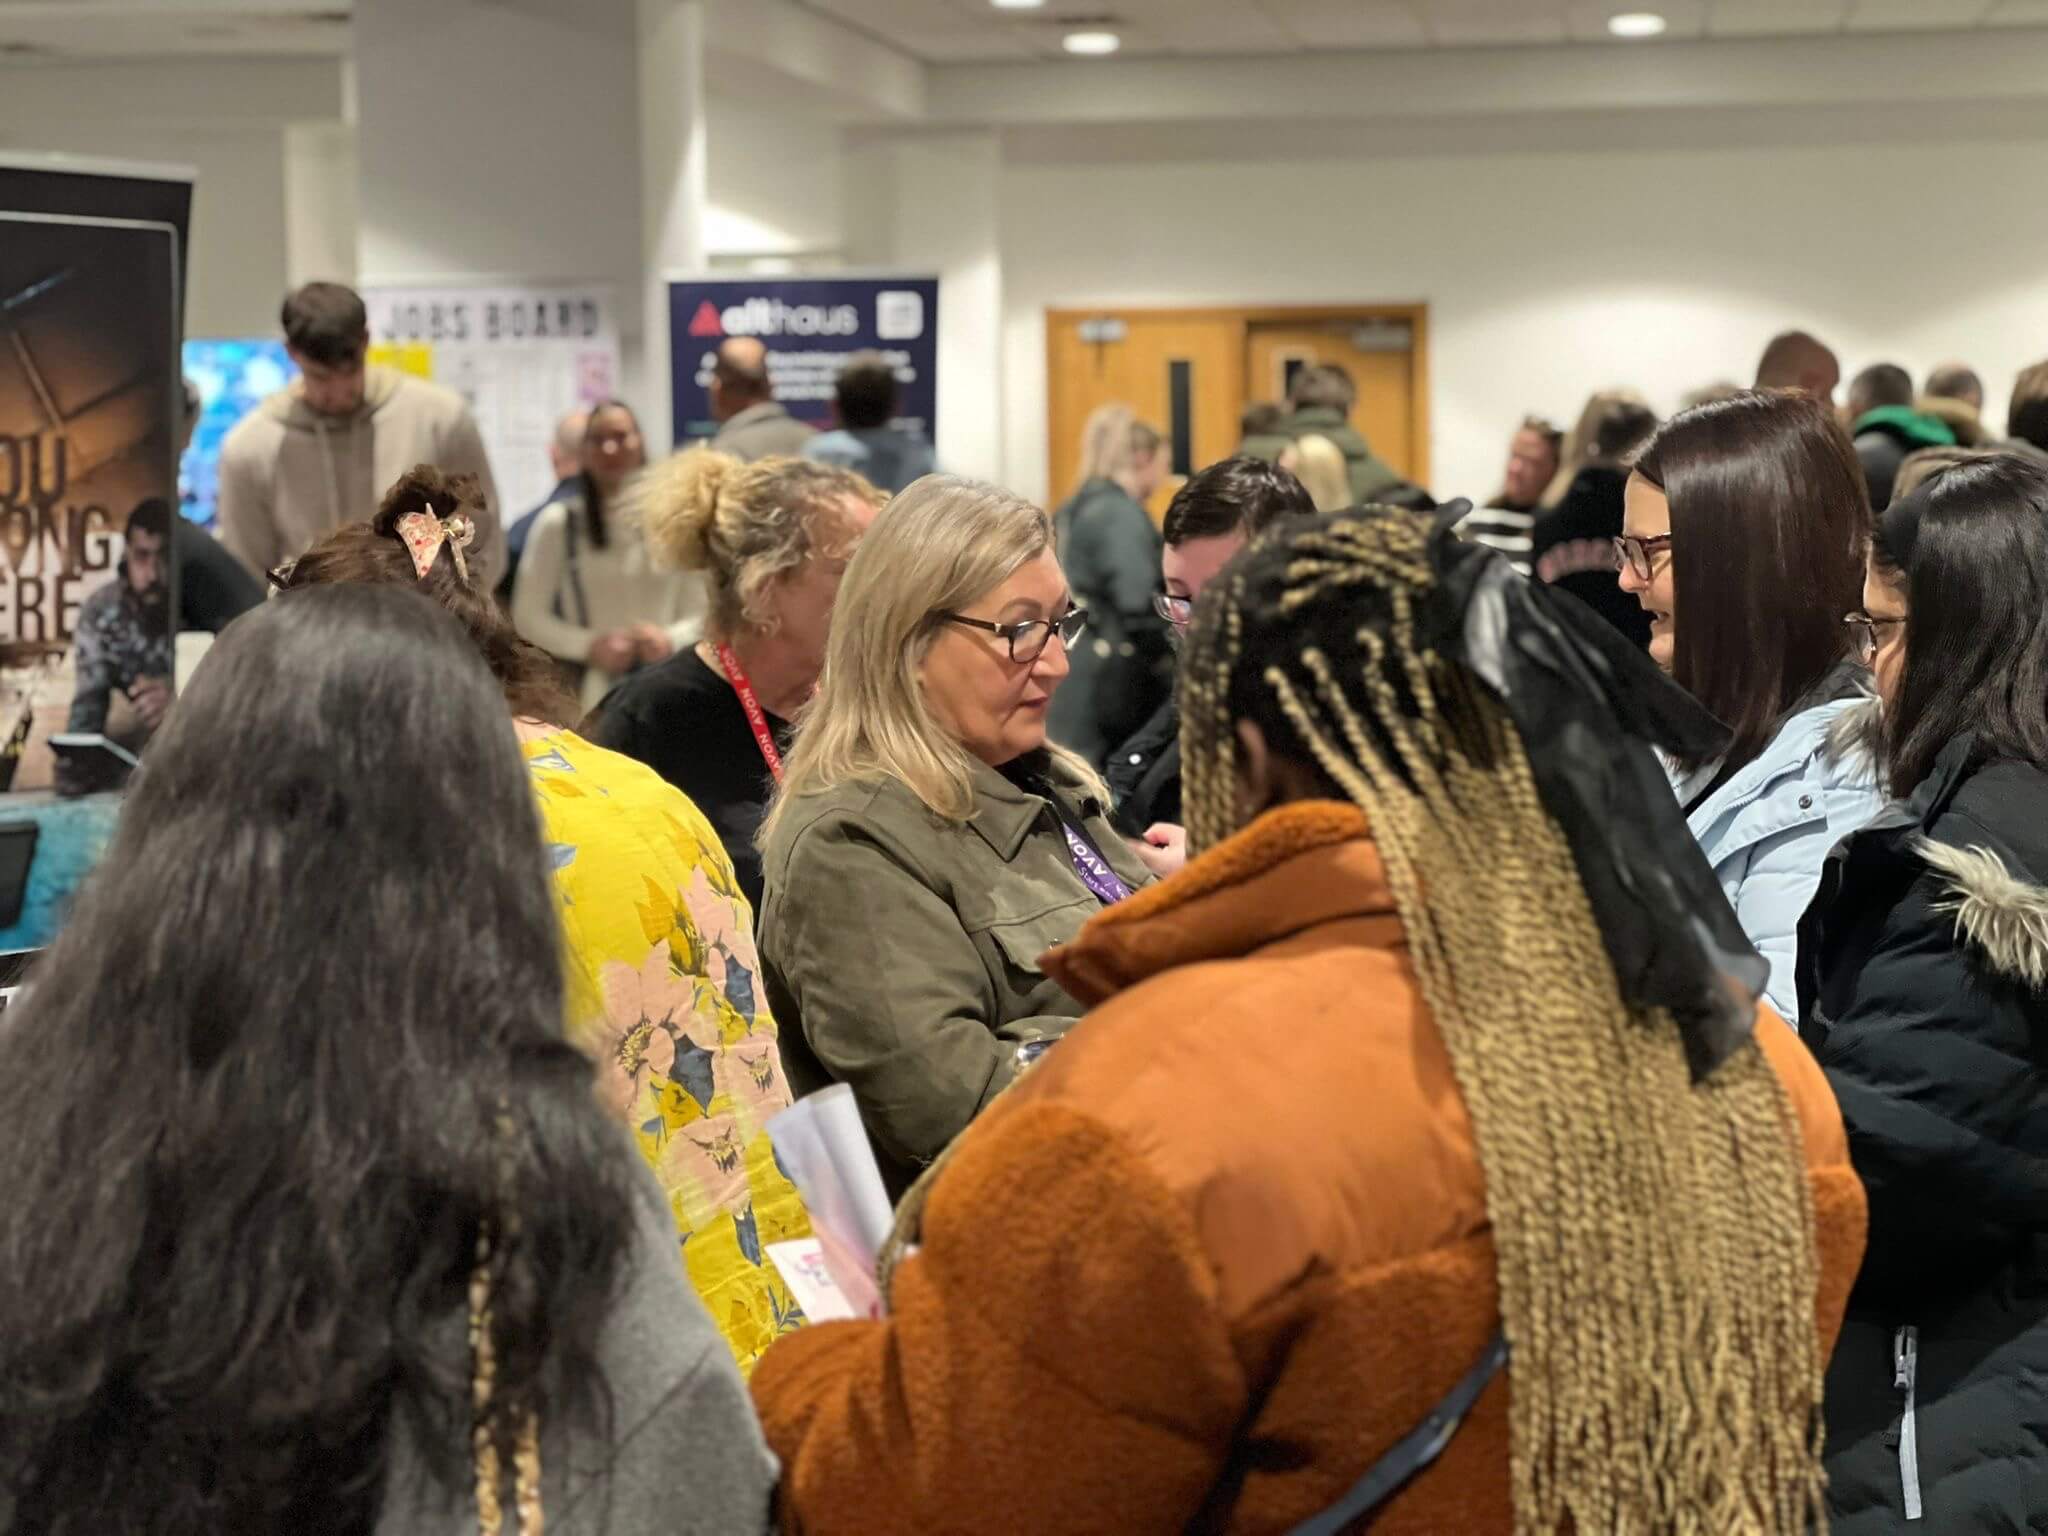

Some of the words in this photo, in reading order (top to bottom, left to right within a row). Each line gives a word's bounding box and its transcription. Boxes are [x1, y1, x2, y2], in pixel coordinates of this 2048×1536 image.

[382, 302, 470, 340] JOBS
[487, 300, 599, 339] BOARD
[0, 573, 83, 640] RE
[740, 687, 763, 726] AVON
[759, 733, 782, 770] AVON
